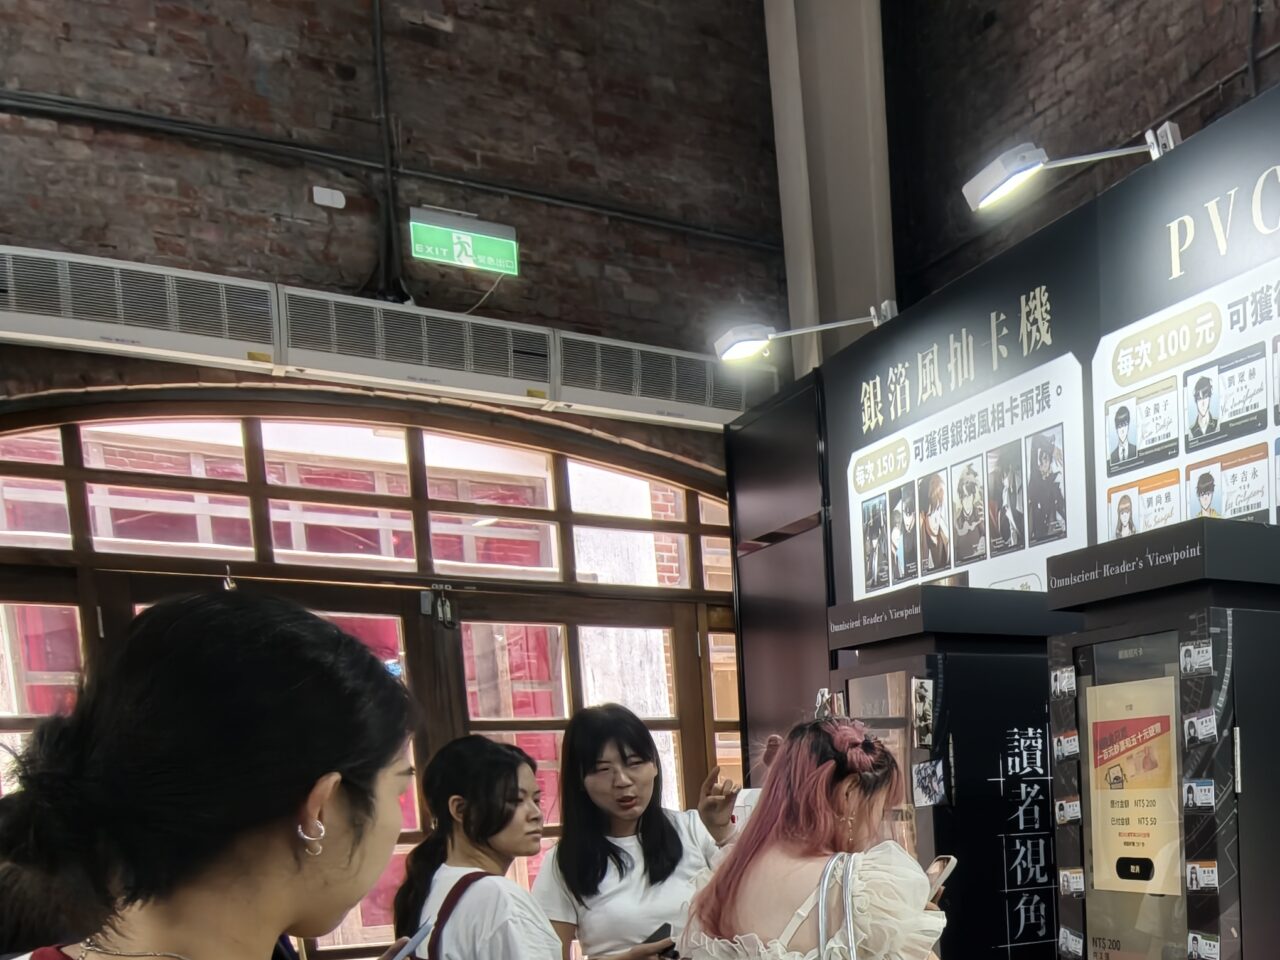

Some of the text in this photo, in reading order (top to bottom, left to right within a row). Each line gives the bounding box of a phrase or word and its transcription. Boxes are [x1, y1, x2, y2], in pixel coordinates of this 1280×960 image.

[415, 244, 448, 256] EXIT
[861, 285, 1053, 434] 銀箔風抽卡機
[912, 381, 1063, 463] 可獲得銀箔風相卡兩張。
[1050, 569, 1099, 588] Omniscient
[1103, 556, 1144, 577] Reader's
[1148, 544, 1201, 566] Viewpoint
